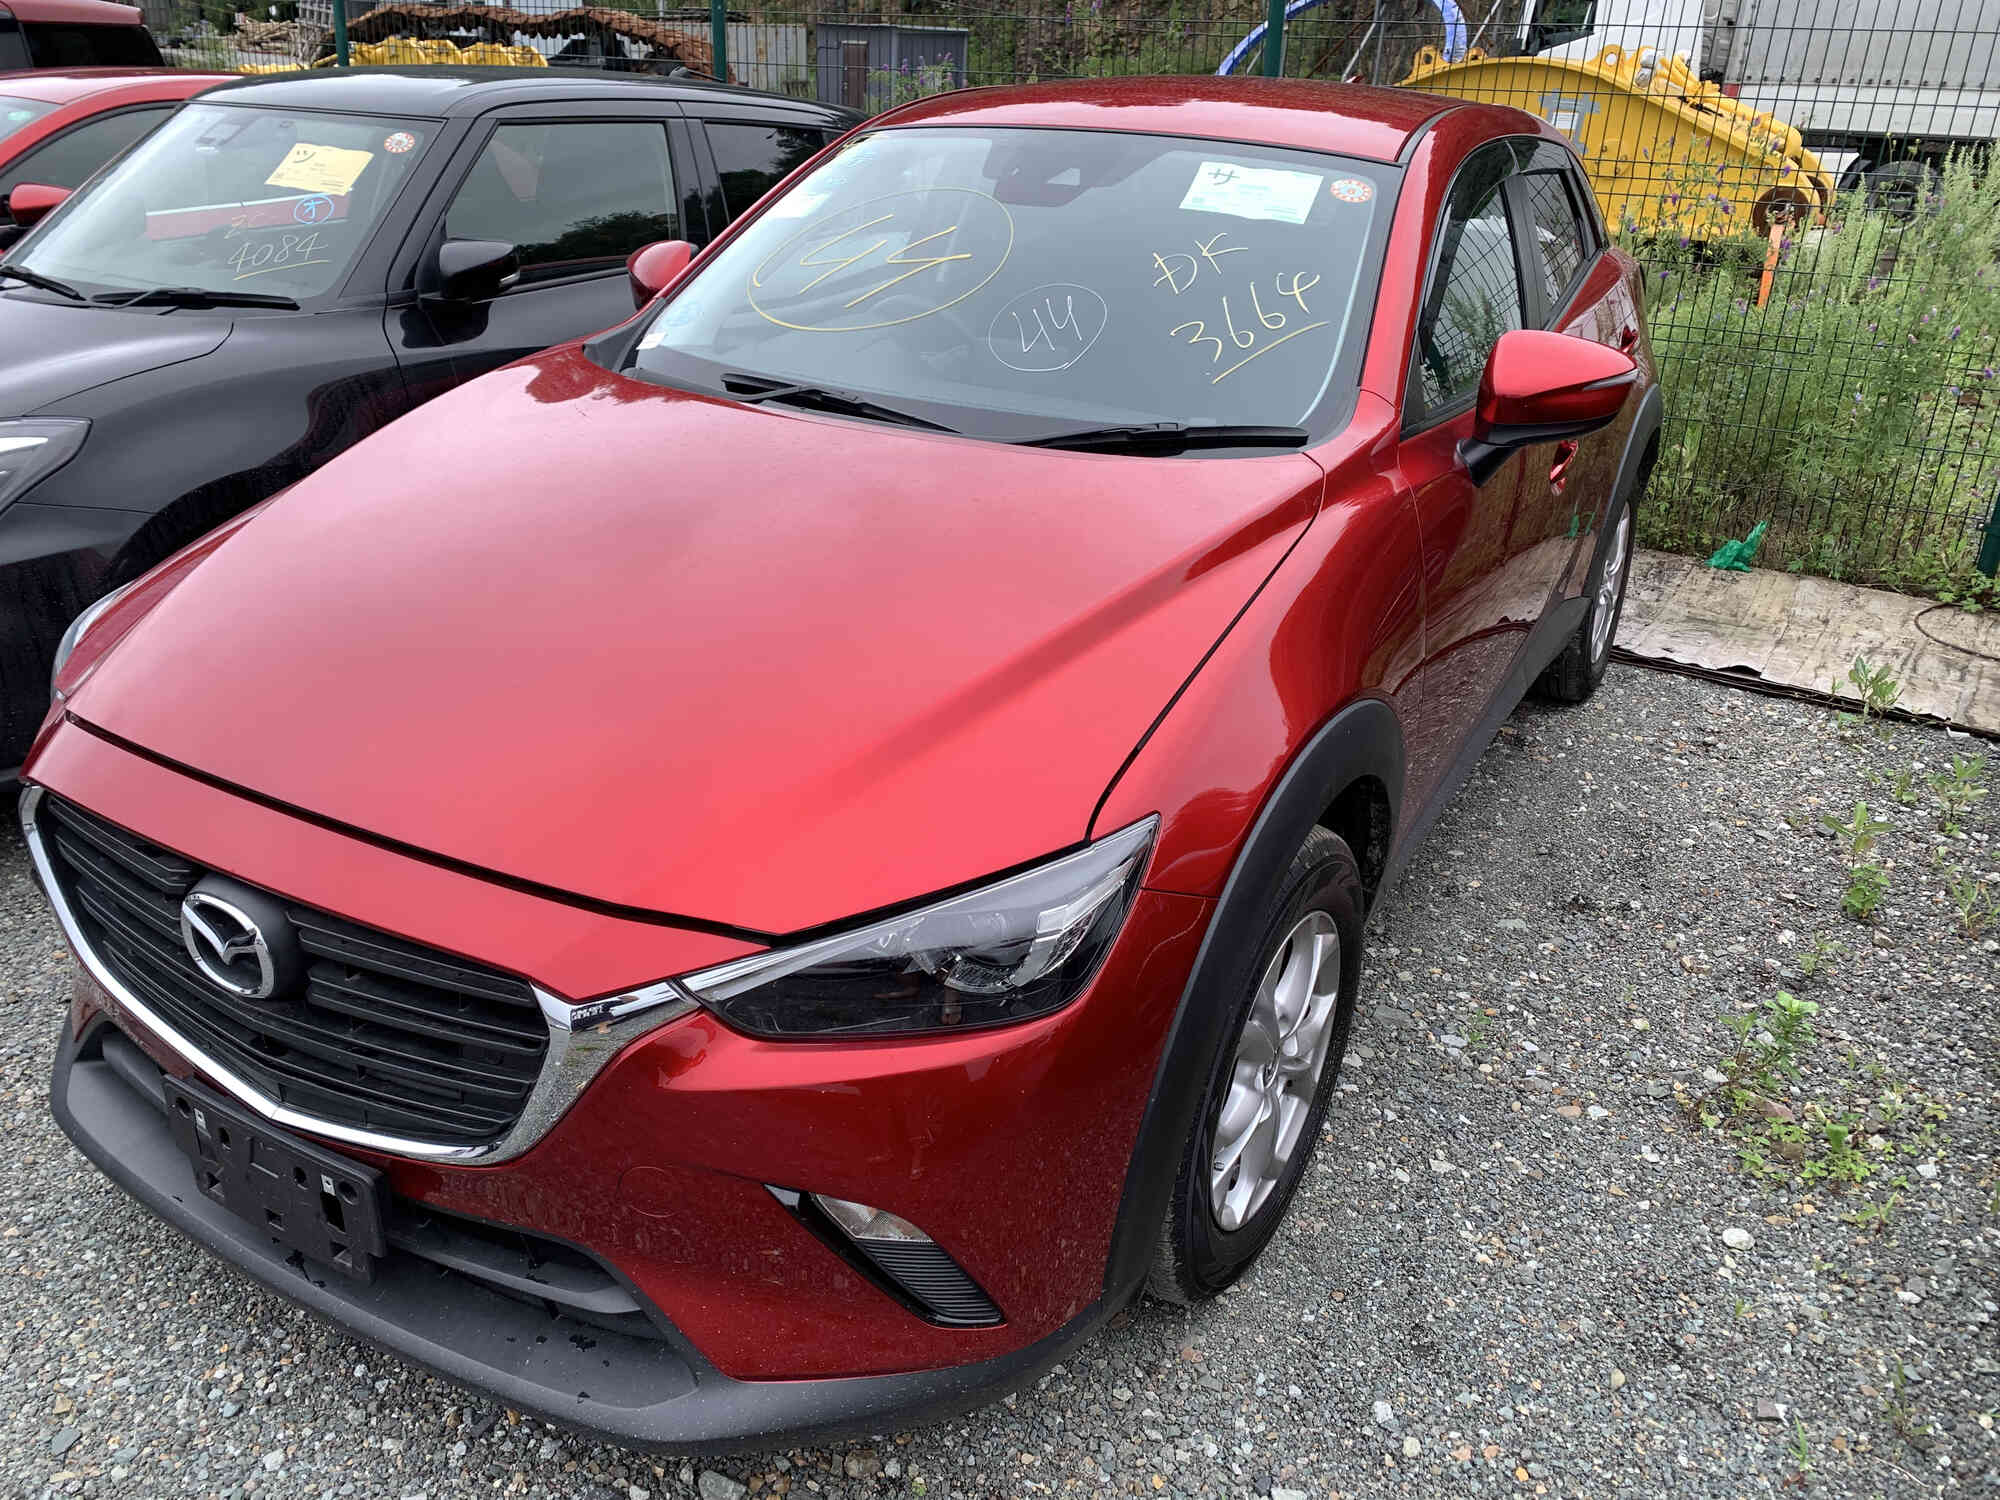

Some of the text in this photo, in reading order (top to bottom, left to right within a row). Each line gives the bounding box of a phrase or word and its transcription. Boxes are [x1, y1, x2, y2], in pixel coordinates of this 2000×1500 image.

[227, 231, 329, 273] 4084
[1012, 295, 1083, 353] 44
[1169, 271, 1321, 363] 3664
